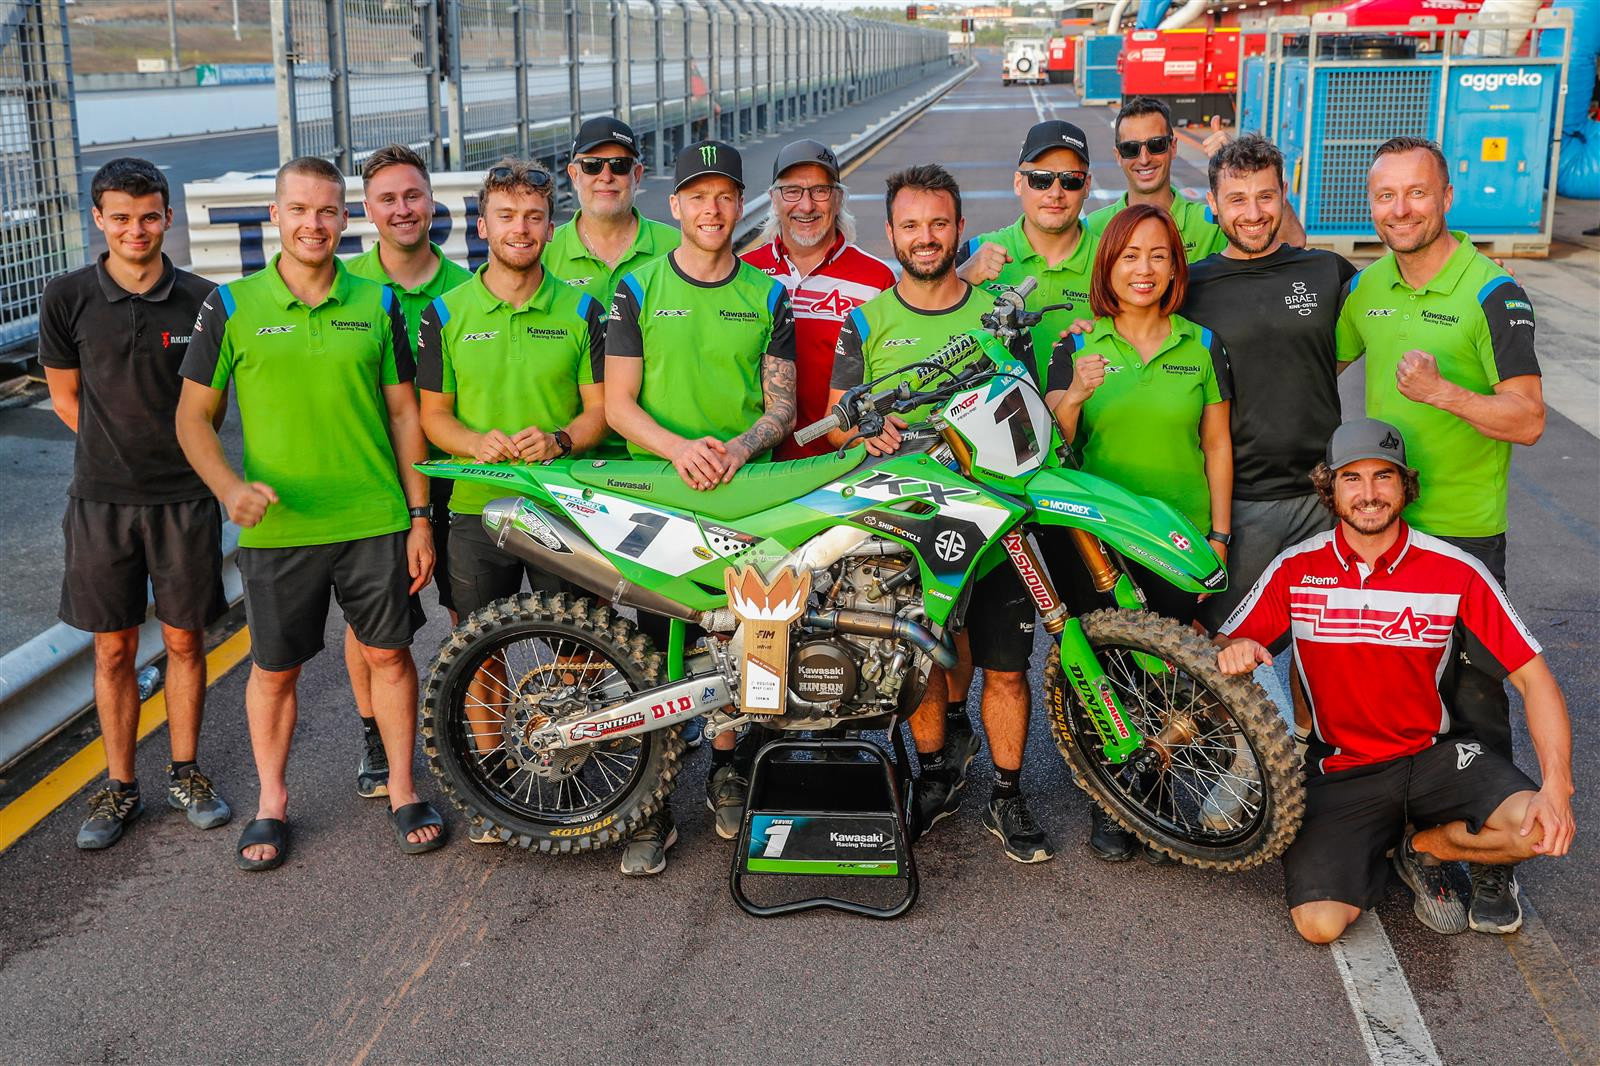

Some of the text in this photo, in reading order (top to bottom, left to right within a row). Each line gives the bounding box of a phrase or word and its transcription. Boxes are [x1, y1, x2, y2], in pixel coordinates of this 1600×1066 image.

[1460, 68, 1542, 91] aggreko
[1284, 293, 1318, 305] BRAET
[655, 309, 694, 319] KX
[719, 309, 760, 320] Kawasaki
[1366, 308, 1397, 318] KX
[1421, 309, 1460, 324] Kawasaki
[256, 325, 297, 336] KX
[331, 319, 372, 330] Kawasaki
[527, 326, 569, 336] Kawasaki
[463, 331, 501, 343] KX
[882, 338, 921, 348] KX
[1162, 364, 1202, 373] Kawasaki
[1000, 366, 1025, 387] MOTREX
[993, 386, 1041, 466] 1
[461, 467, 515, 480] DUNLOP
[980, 468, 1008, 481] Kawasaki
[607, 478, 652, 491] Kawasaki
[855, 471, 977, 506] KX
[1050, 500, 1090, 515] MOTOREX
[615, 512, 670, 559] 1
[1013, 554, 1055, 610] SHOWA
[1301, 573, 1339, 586] Astemo
[756, 630, 776, 640] FIM
[798, 665, 845, 676] Kawasaki
[799, 682, 844, 693] HINSON
[1069, 665, 1120, 747] DUNLOP
[1053, 686, 1073, 743] DUNLOP
[549, 815, 614, 837] DUNLOP
[763, 824, 792, 858] 1
[830, 832, 883, 843] Kawasaki
